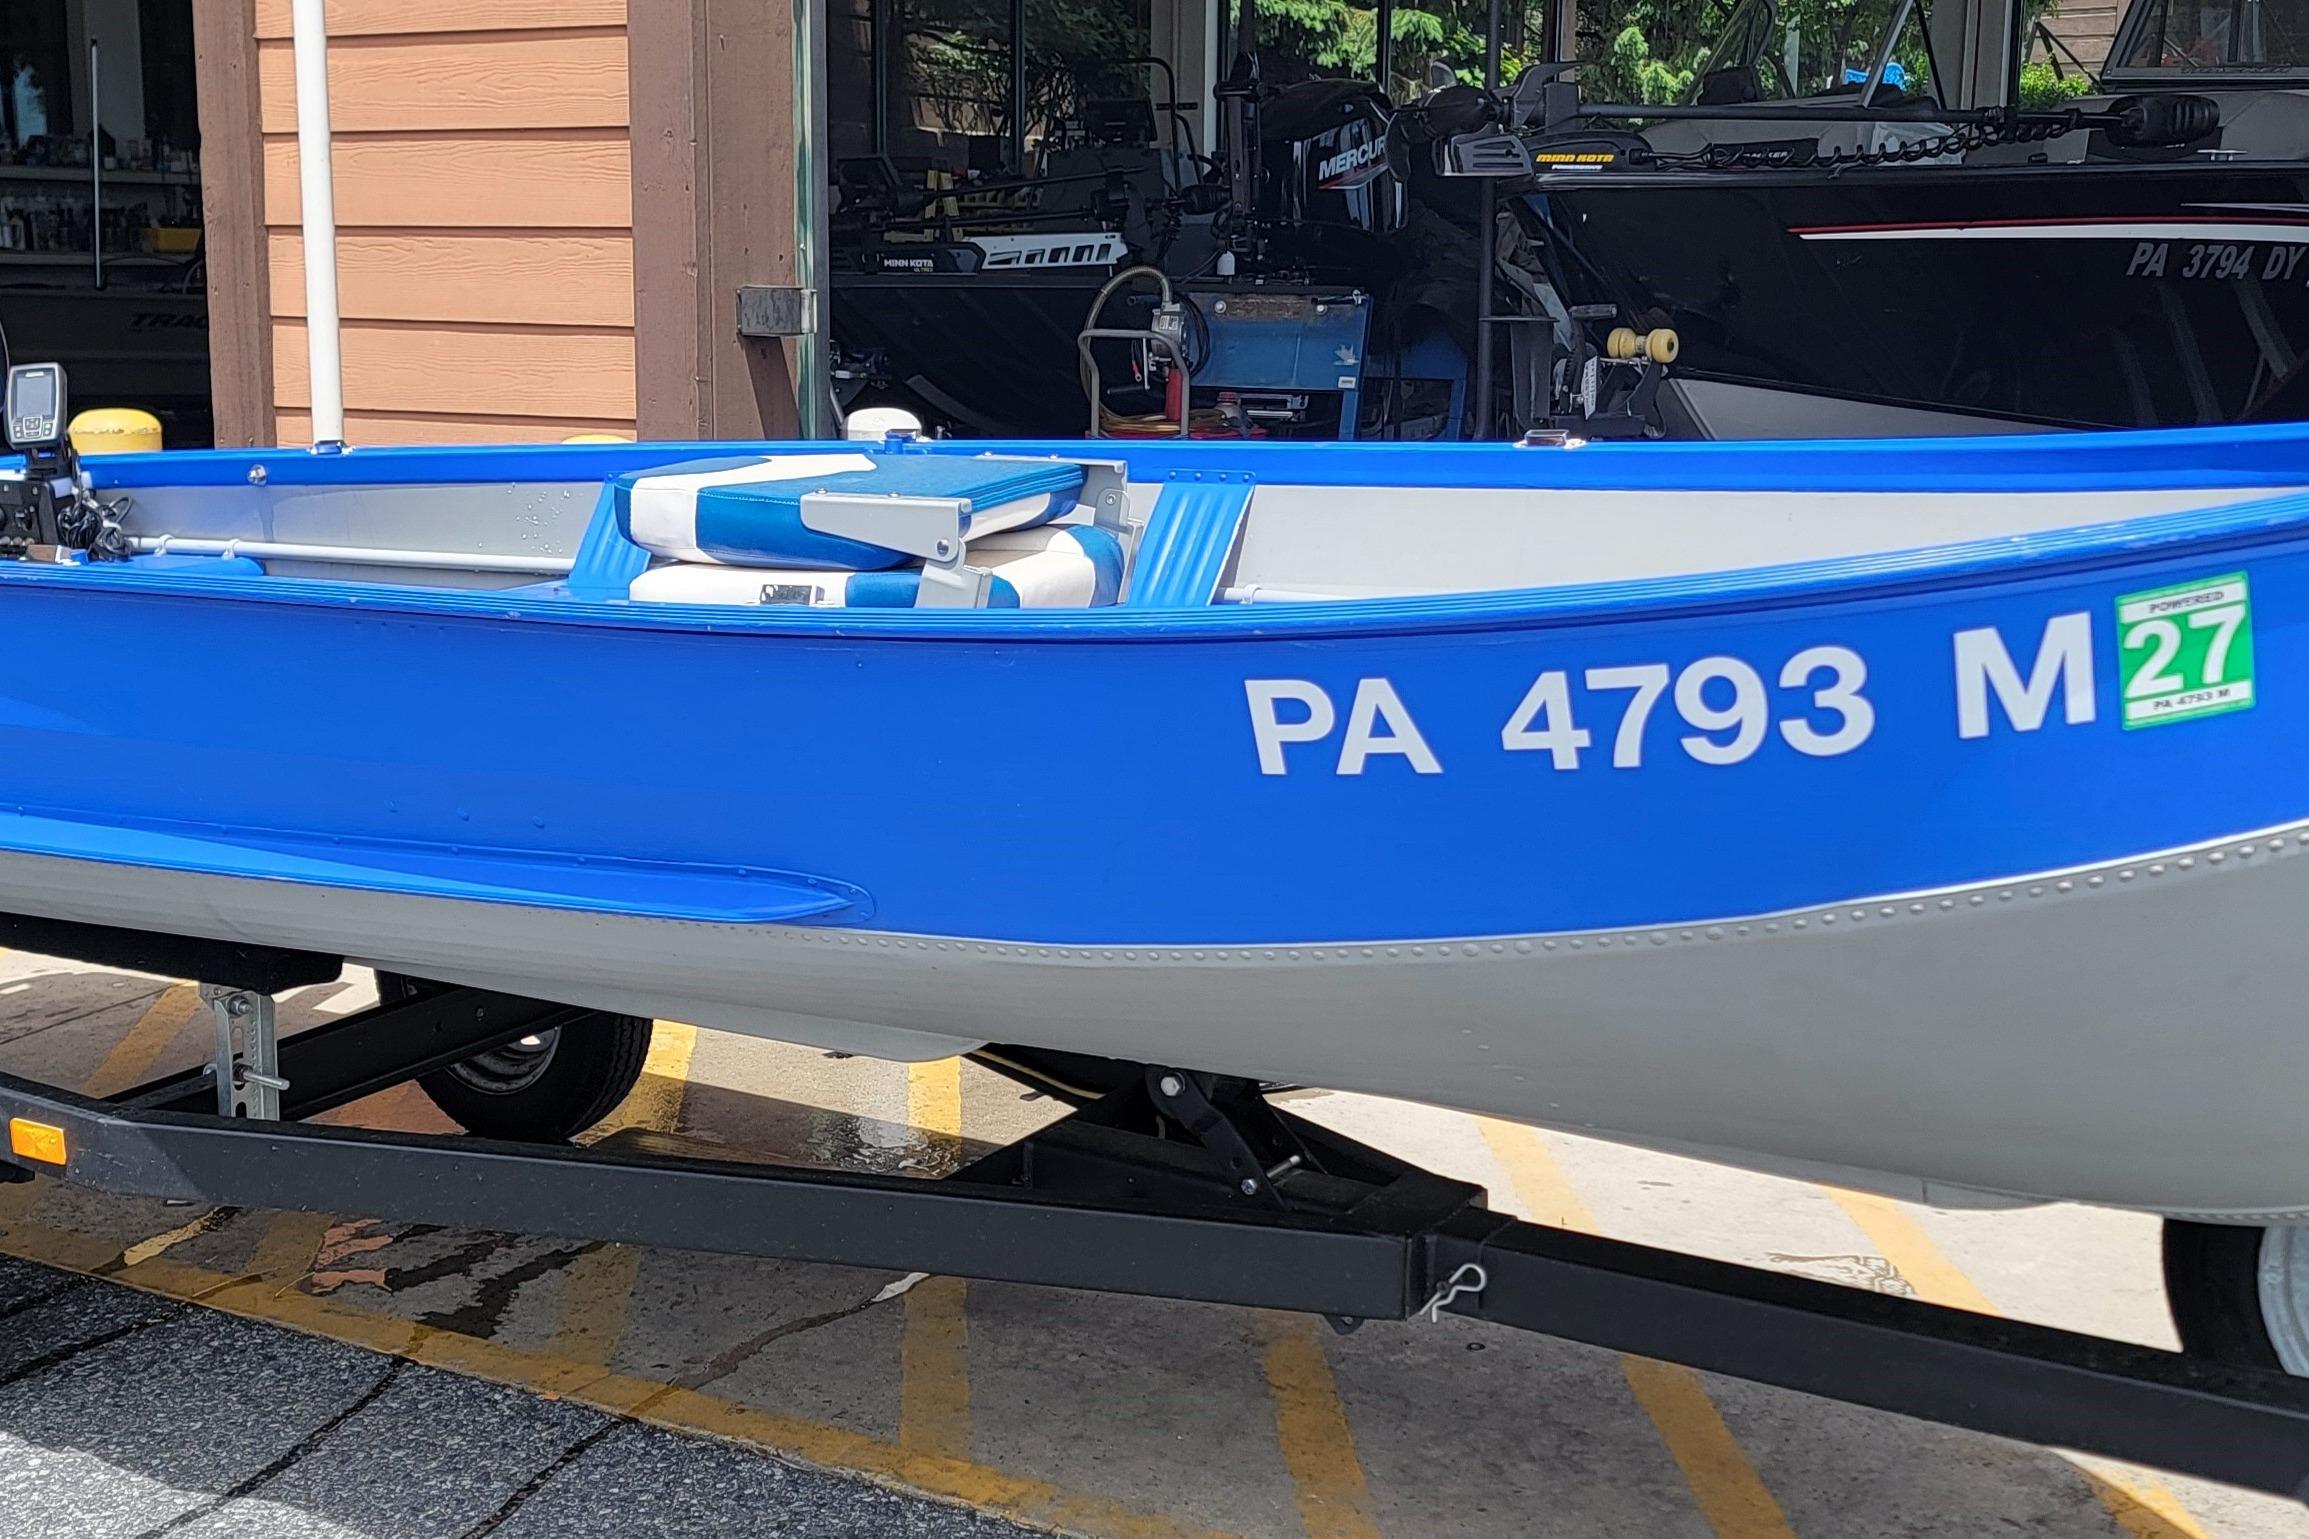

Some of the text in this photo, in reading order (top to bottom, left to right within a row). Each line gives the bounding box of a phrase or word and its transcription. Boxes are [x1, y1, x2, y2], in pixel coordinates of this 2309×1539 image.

[1318, 135, 1387, 181] MERCUR
[1536, 154, 1615, 163] MINN KOTA
[884, 258, 933, 267] MINN KOTA
[2126, 242, 2307, 280] PA 3794 DY
[130, 312, 207, 329] TRAC
[2149, 591, 2224, 613] POWERED
[2124, 603, 2246, 698] 27
[1244, 612, 2096, 775] PA 4793 M
[2153, 688, 2231, 710] PA 4793 M
